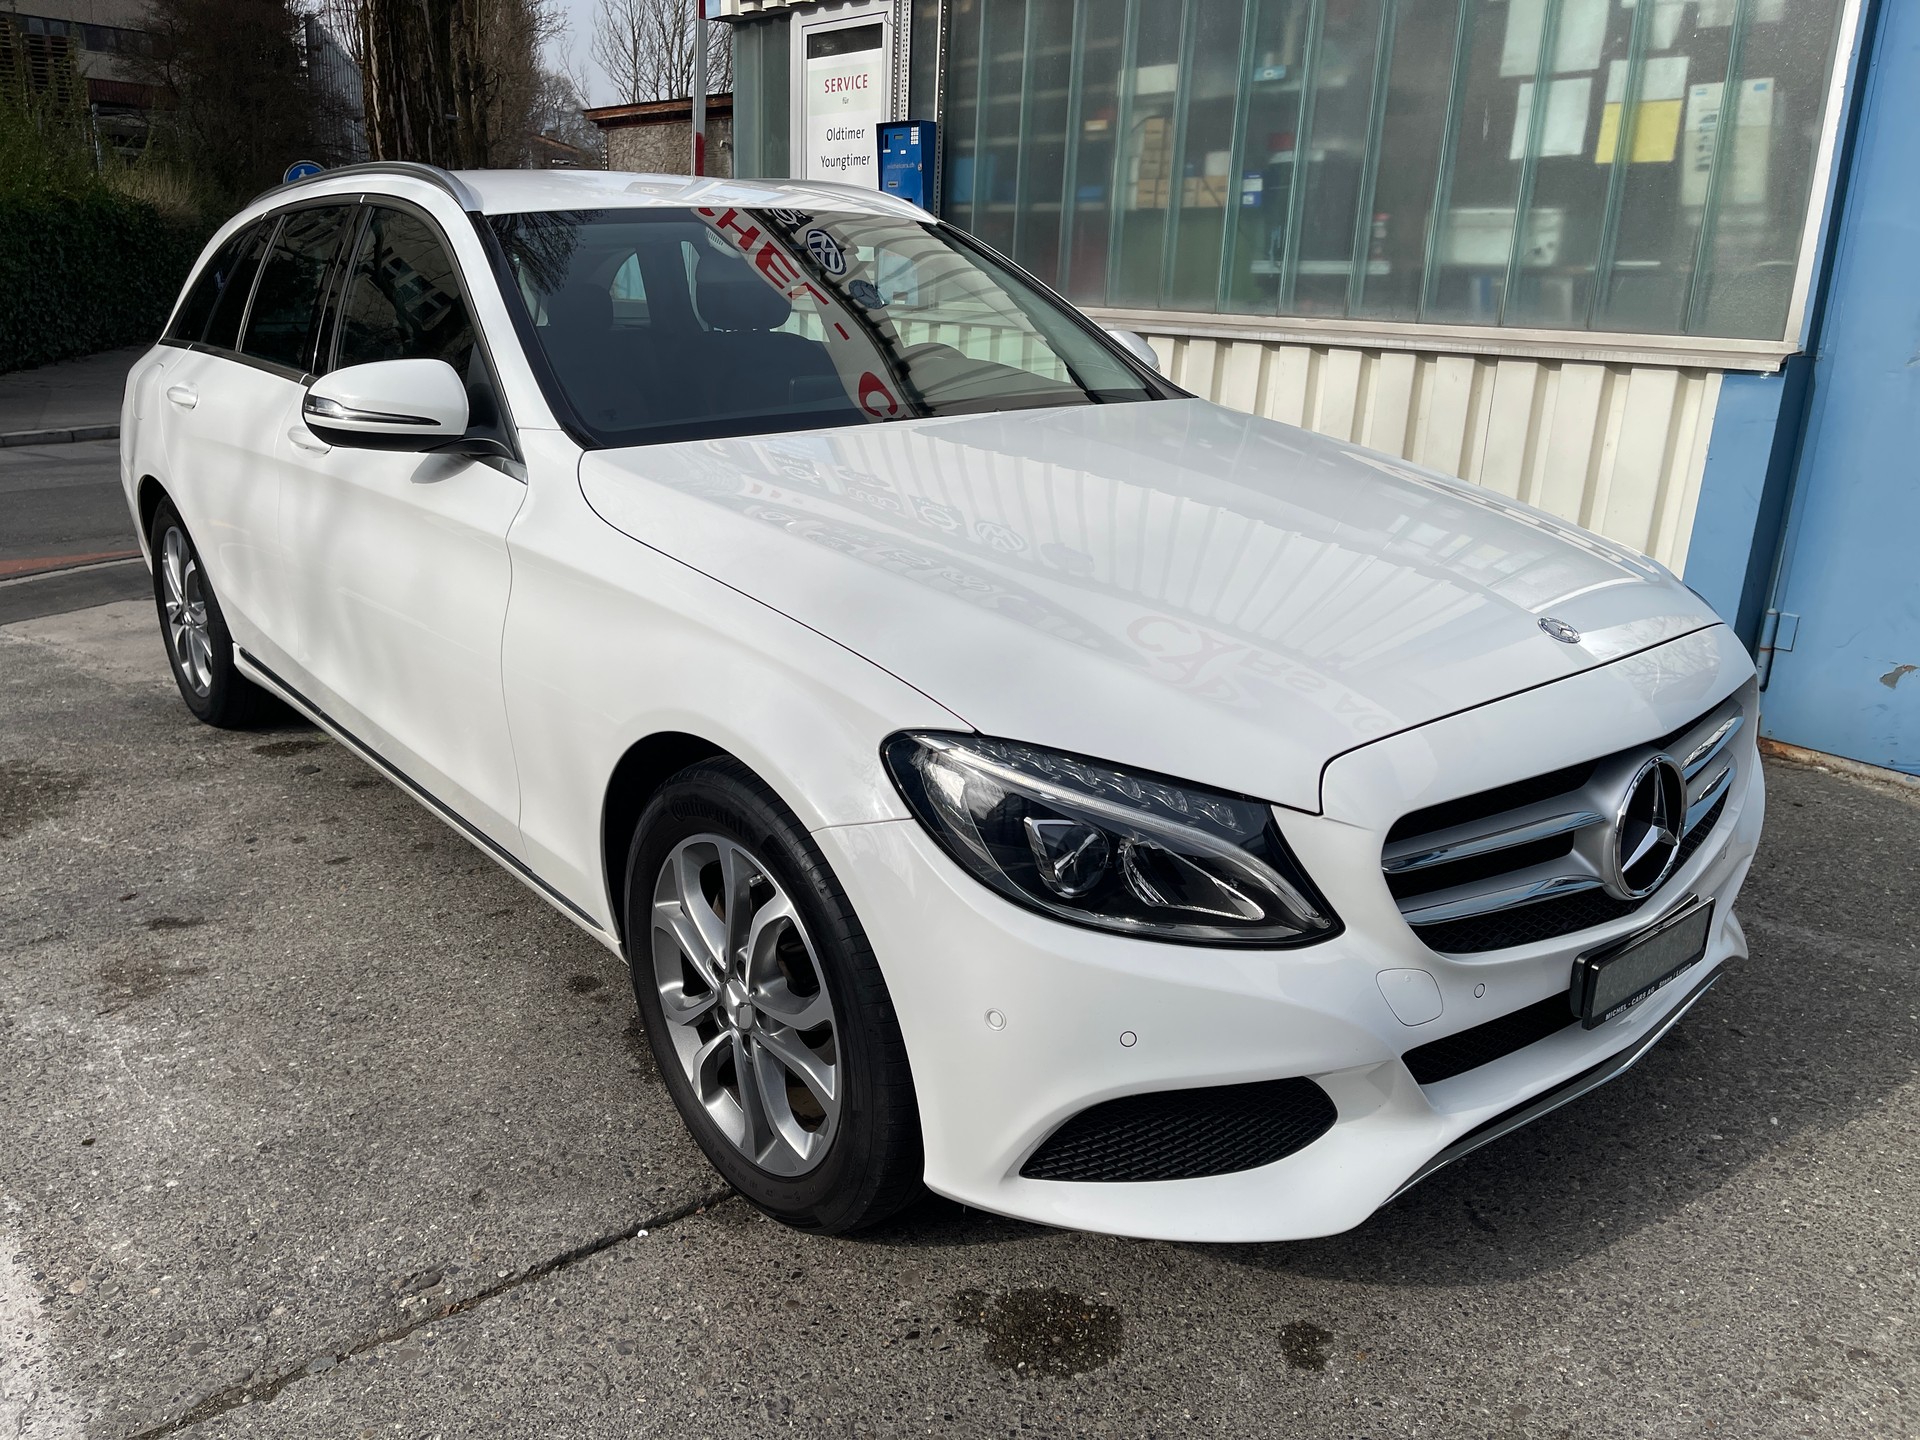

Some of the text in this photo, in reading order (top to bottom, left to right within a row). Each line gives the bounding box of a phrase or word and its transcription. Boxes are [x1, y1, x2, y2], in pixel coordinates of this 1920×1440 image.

[824, 74, 868, 94] SERVICE
[826, 127, 865, 141] Oldtimer
[820, 153, 870, 171] Youngtimer
[1605, 1004, 1627, 1020] MICHEL
[1631, 991, 1646, 1005] CARS
